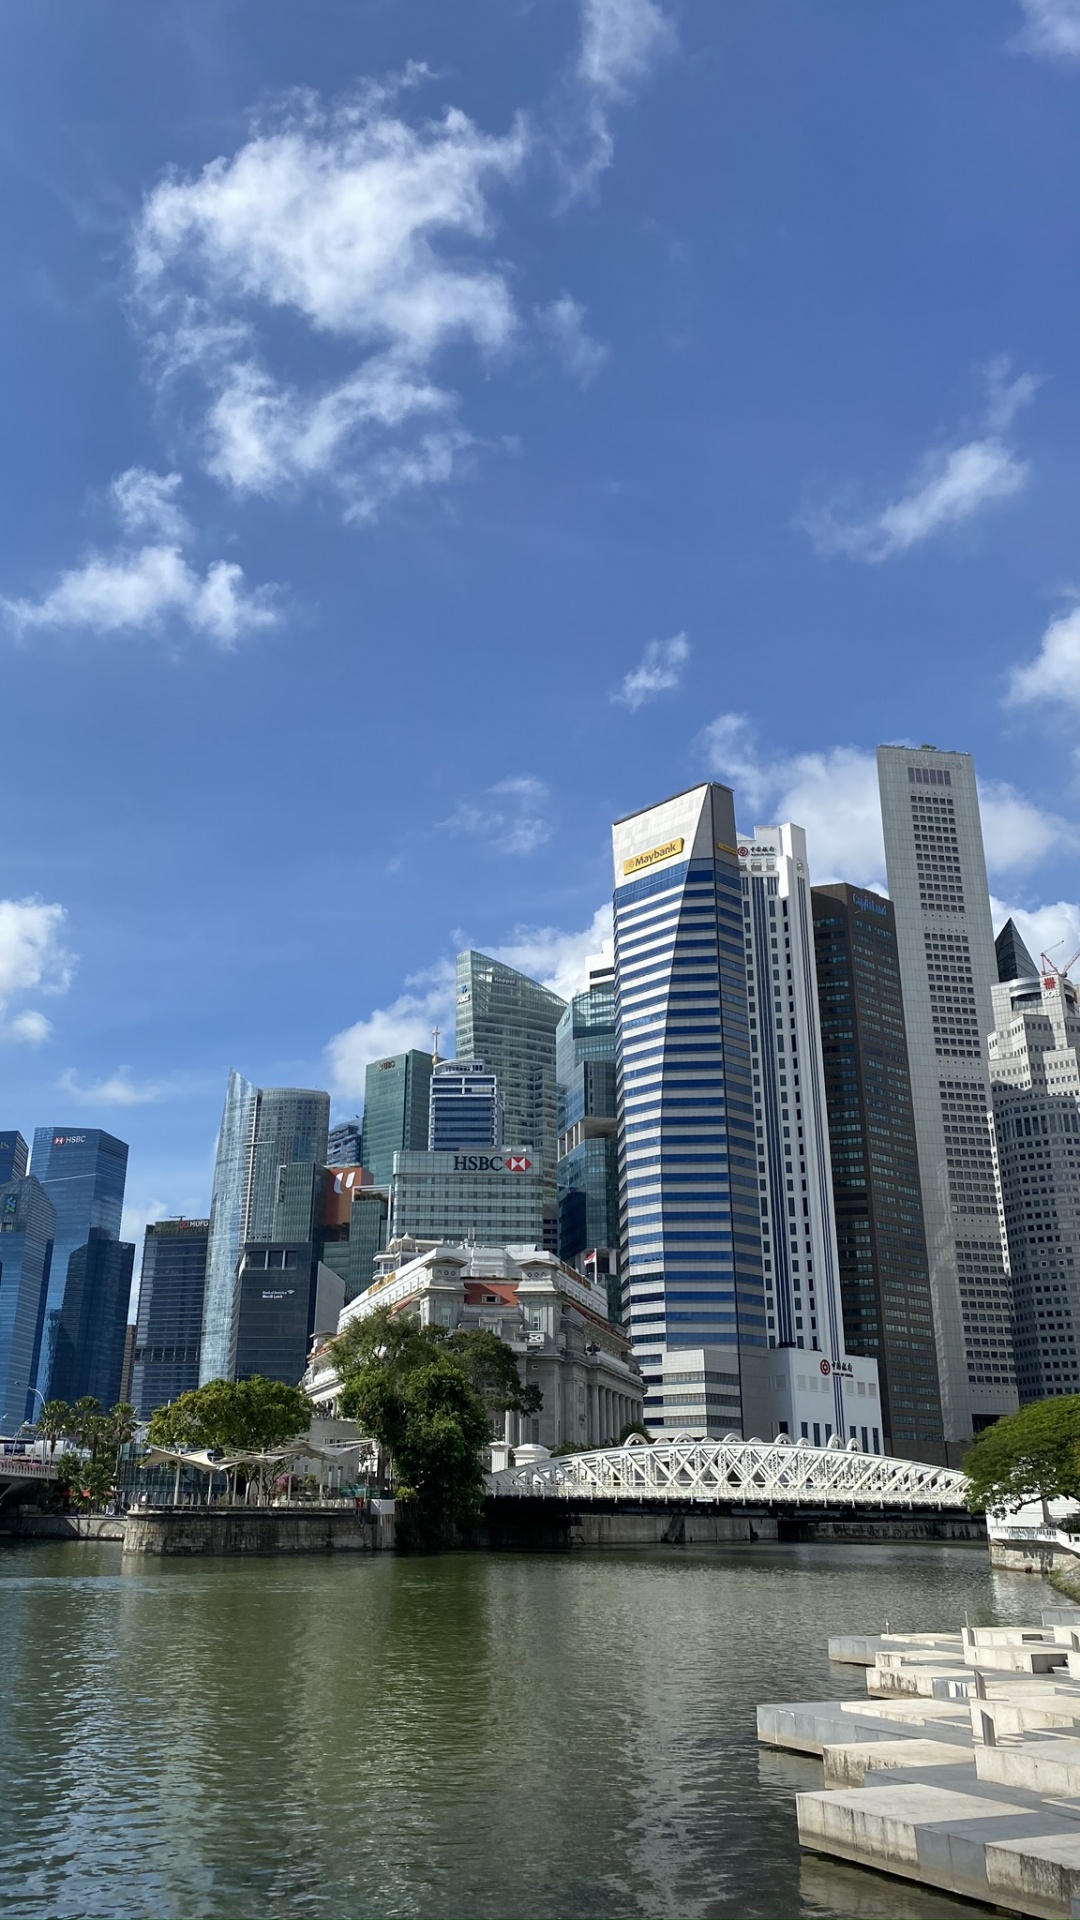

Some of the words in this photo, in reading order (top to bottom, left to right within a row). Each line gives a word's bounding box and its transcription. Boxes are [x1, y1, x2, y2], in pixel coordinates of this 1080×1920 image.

[635, 843, 676, 866] Maybank
[494, 977, 516, 985] Keppel
[1041, 991, 1060, 999] UOB
[65, 1135, 86, 1143] HSBC
[453, 1156, 503, 1172] HSBC
